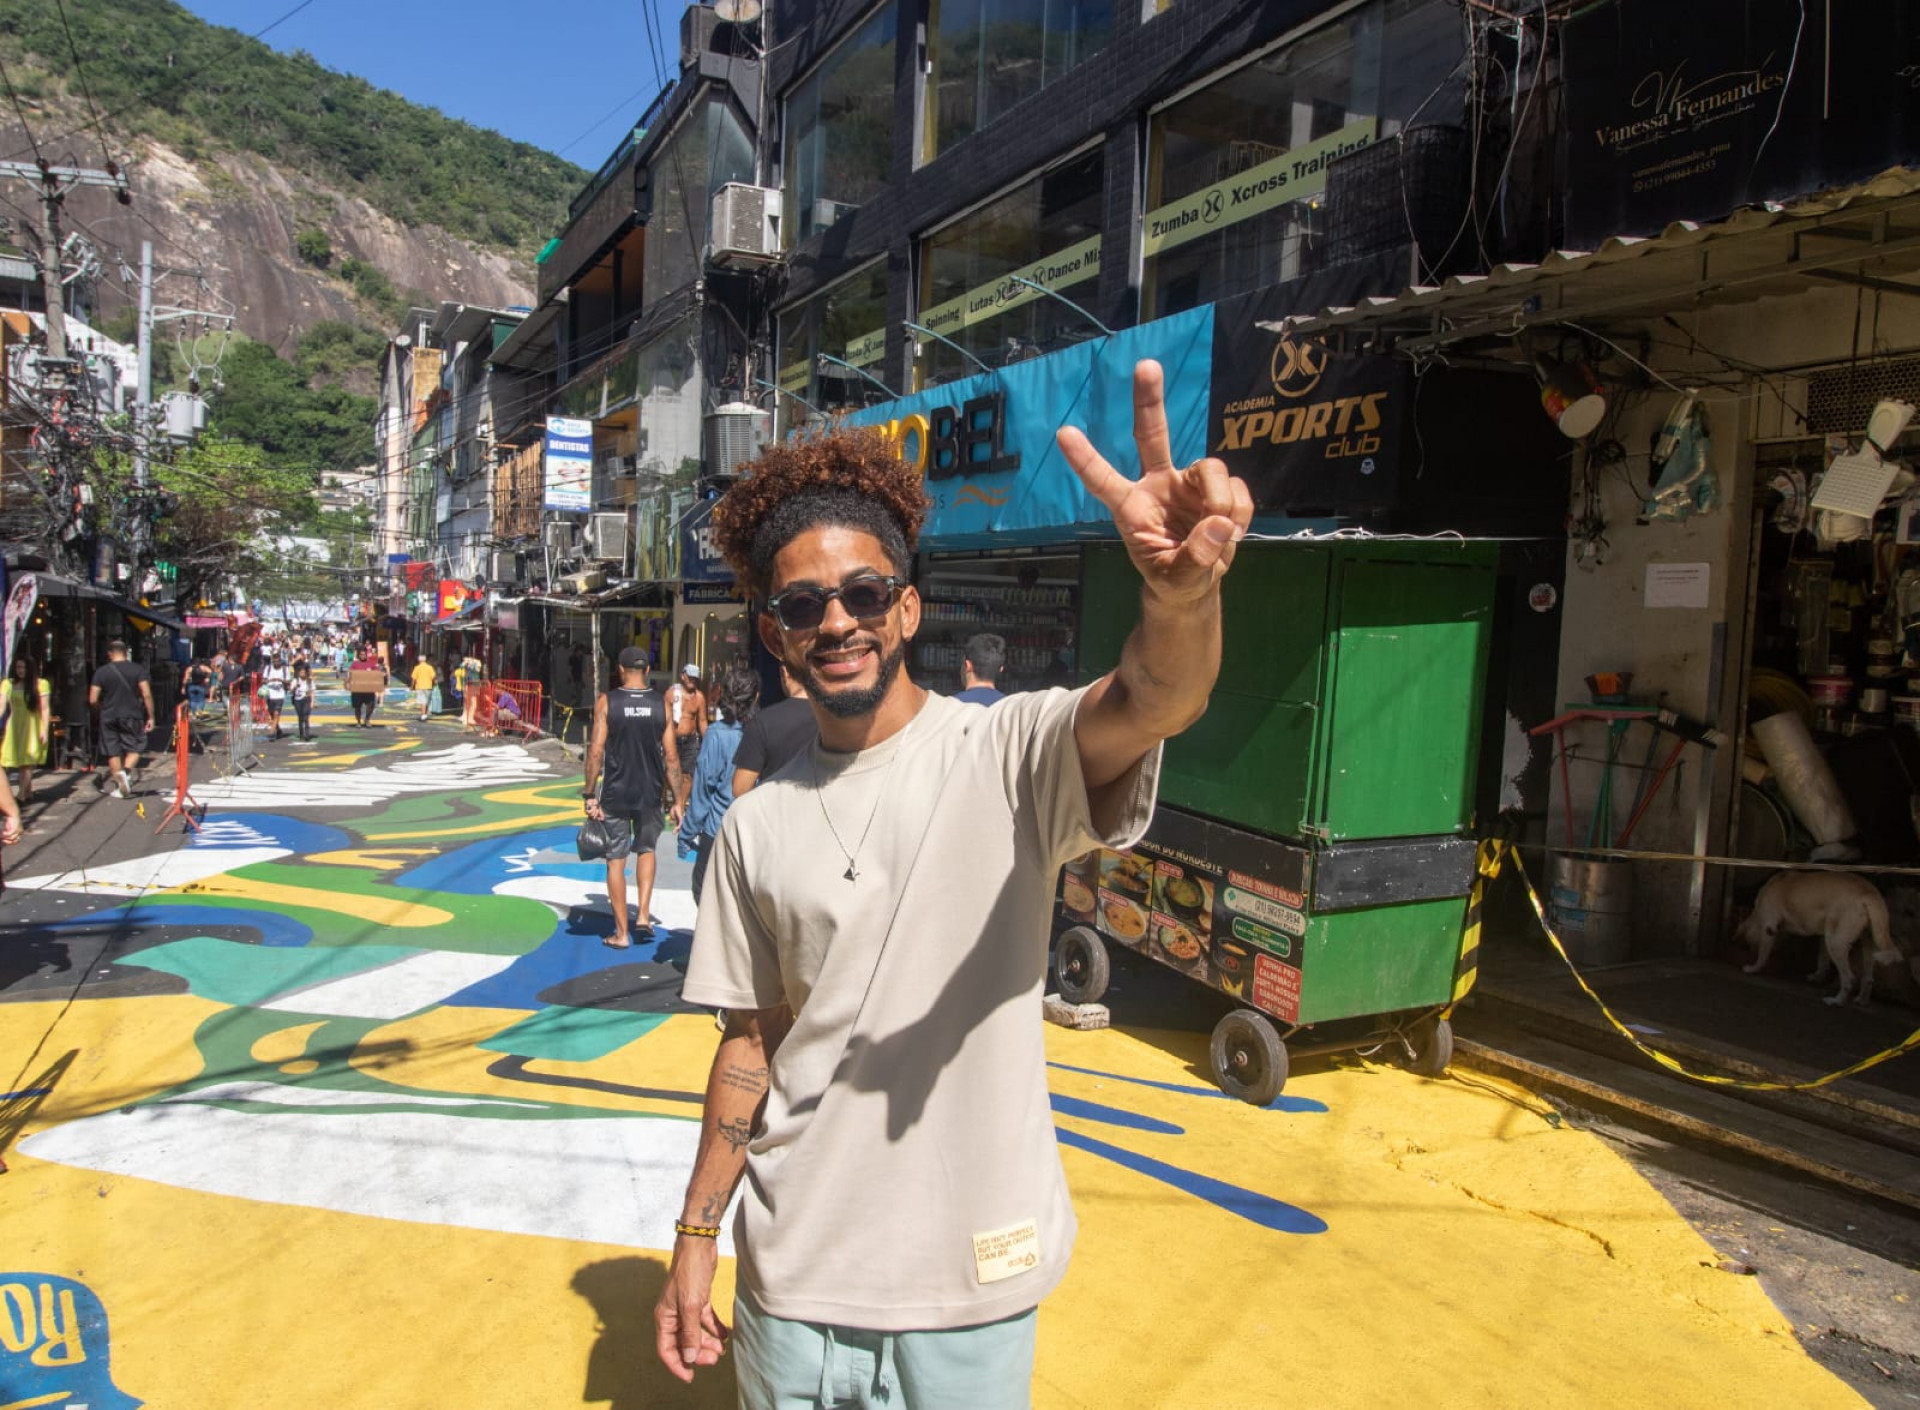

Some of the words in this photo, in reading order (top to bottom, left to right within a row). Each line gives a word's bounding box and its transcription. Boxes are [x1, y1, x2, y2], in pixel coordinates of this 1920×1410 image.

[1596, 112, 1669, 147] Vanessa
[1675, 72, 1785, 121] Fernandes
[1151, 208, 1199, 238] Zumba
[1230, 171, 1288, 206] Xcross
[1047, 258, 1081, 281] Dance
[1084, 249, 1101, 267] Mi
[970, 294, 995, 313] Lutas
[926, 307, 960, 330] Spinning
[1224, 395, 1276, 414] ACADEMIA
[1215, 391, 1388, 452] XPORTS
[1324, 433, 1381, 459] club
[978, 1252, 997, 1262] CAN
[997, 1248, 1009, 1258] BE
